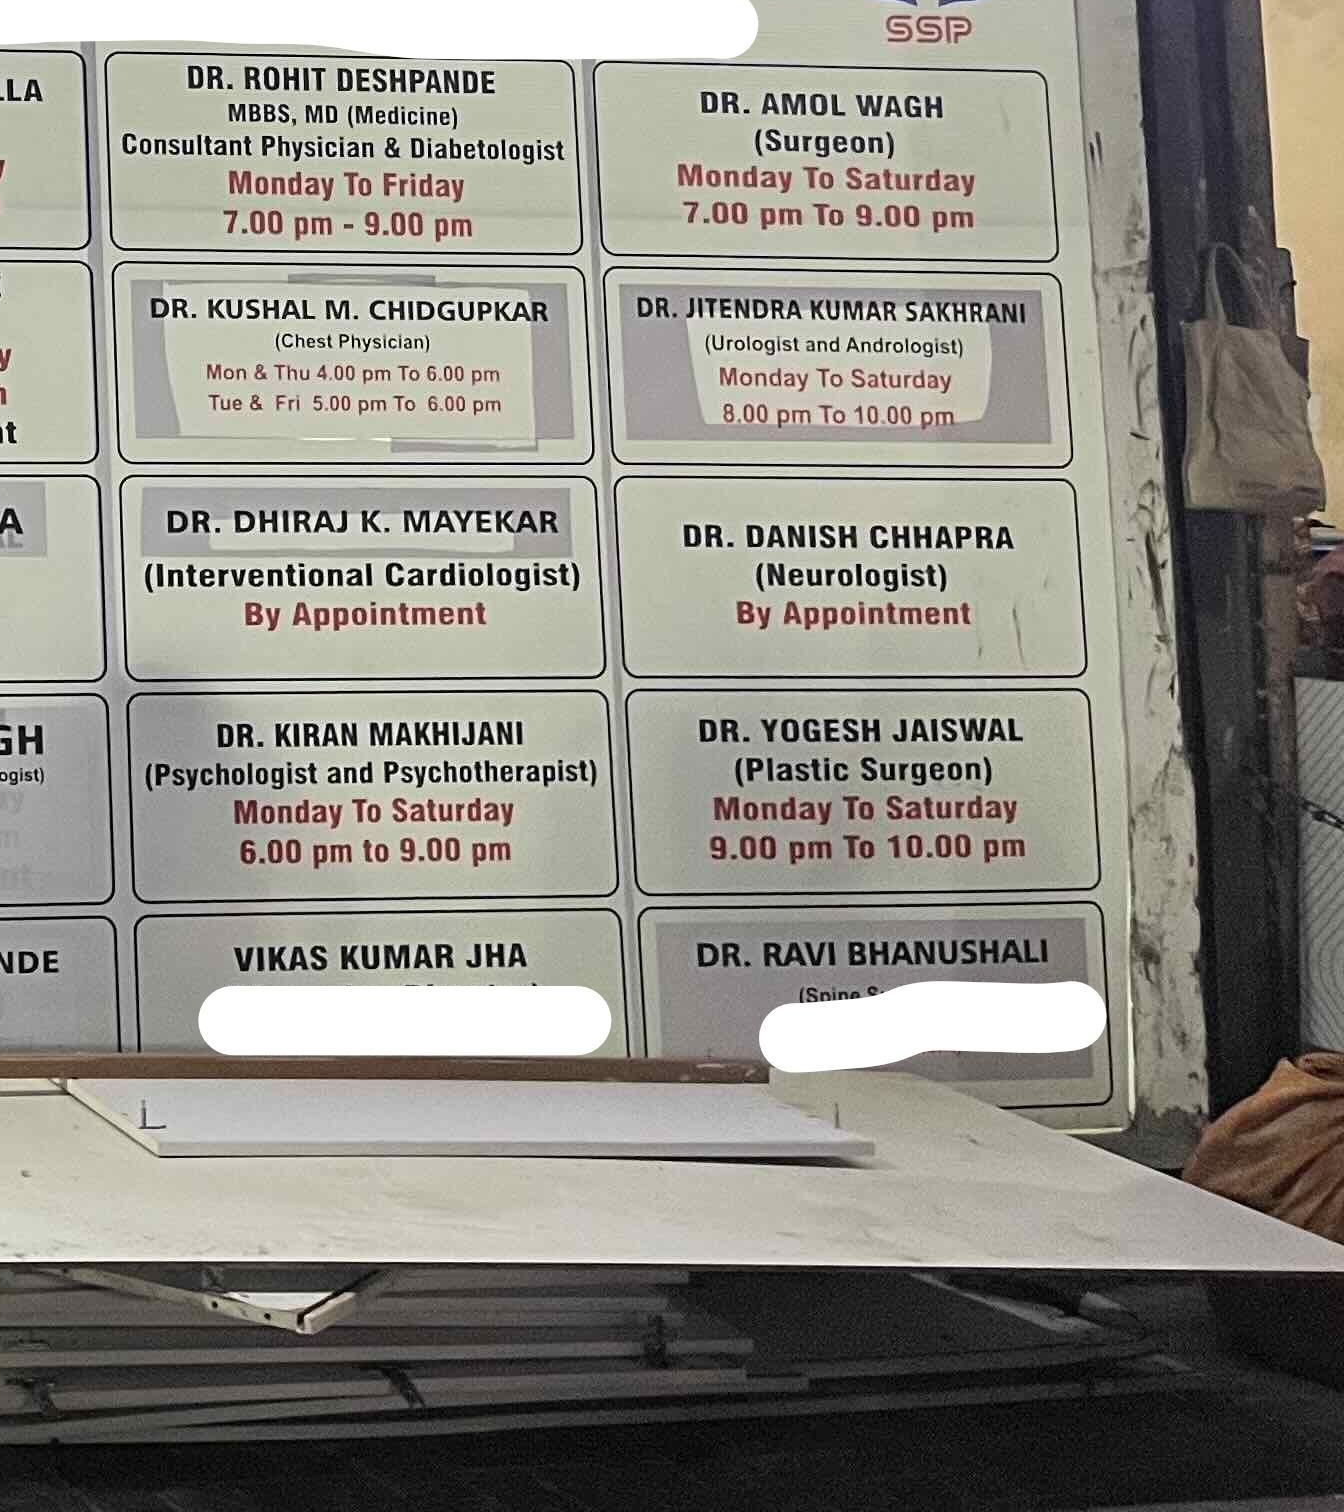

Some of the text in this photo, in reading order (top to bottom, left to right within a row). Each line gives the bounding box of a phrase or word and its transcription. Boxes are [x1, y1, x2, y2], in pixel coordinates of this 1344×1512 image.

[887, 14, 972, 44] SSP
[187, 66, 495, 94] DR. ROHIT DESHPANDE
[228, 104, 458, 129] MBBS, MD (Medicine)
[701, 92, 943, 118] DR. AMOL WAGH
[122, 134, 565, 164] Consultant Physician & Diabetologist
[754, 129, 895, 158] (Surgeon)
[151, 299, 548, 322] DR. KUSHAL M. CHIDGUPKAR
[637, 297, 1025, 323] DR. JITENDRA KUMAR SAKHRANI
[705, 335, 963, 358] (Urologist and Andrologist)
[167, 510, 558, 534] DR. DHIRAJ K. MAYEKAR
[683, 525, 1014, 549] DR. DANISH CHHAPRA
[756, 564, 947, 591] (Neurologist)
[217, 721, 523, 748] DR. KIRAN MAKHIJANI
[699, 718, 1023, 742] DR. YOGESH JAISWAL
[234, 943, 527, 971] VIKAS KUMAR JHA
[696, 939, 1048, 967] DR. RAVI BHANUSHALI
